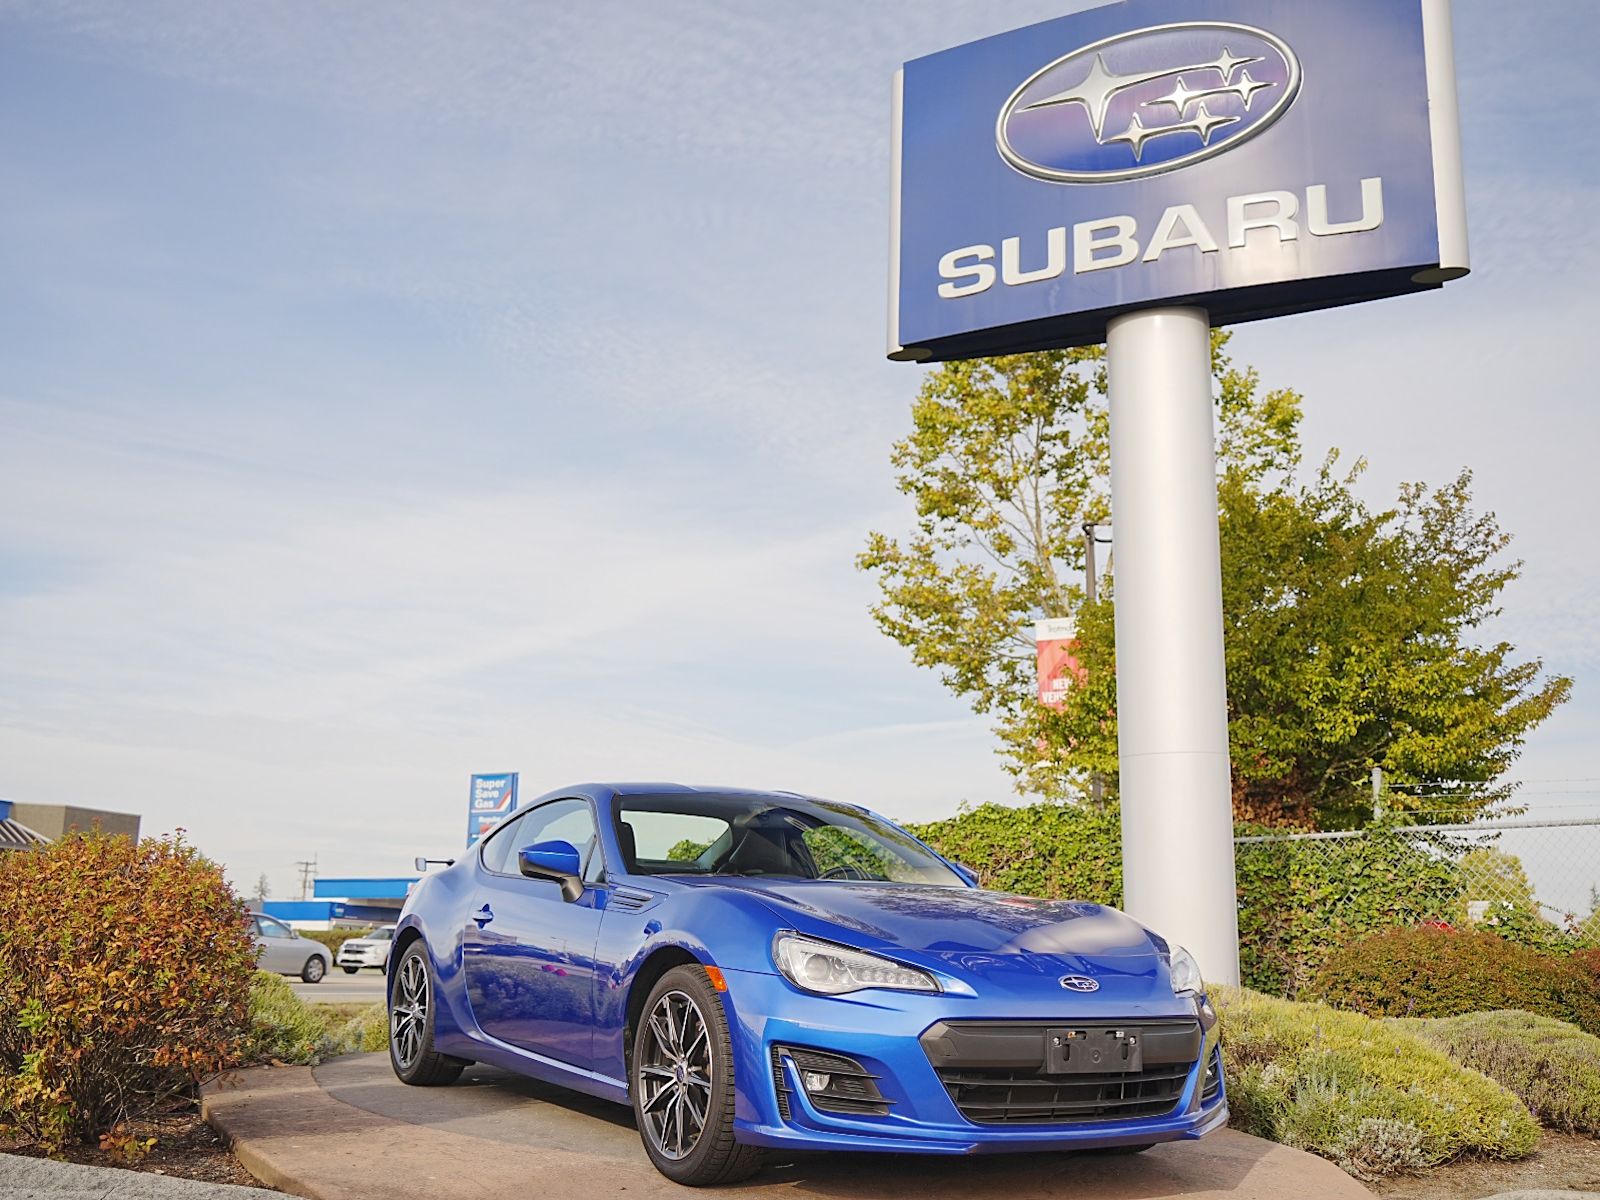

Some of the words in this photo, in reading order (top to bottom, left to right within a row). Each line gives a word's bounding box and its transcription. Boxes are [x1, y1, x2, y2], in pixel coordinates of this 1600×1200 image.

[937, 177, 1384, 299] SUBARU
[476, 778, 505, 790] Super
[476, 789, 499, 799] Save
[475, 799, 494, 808] Gas
